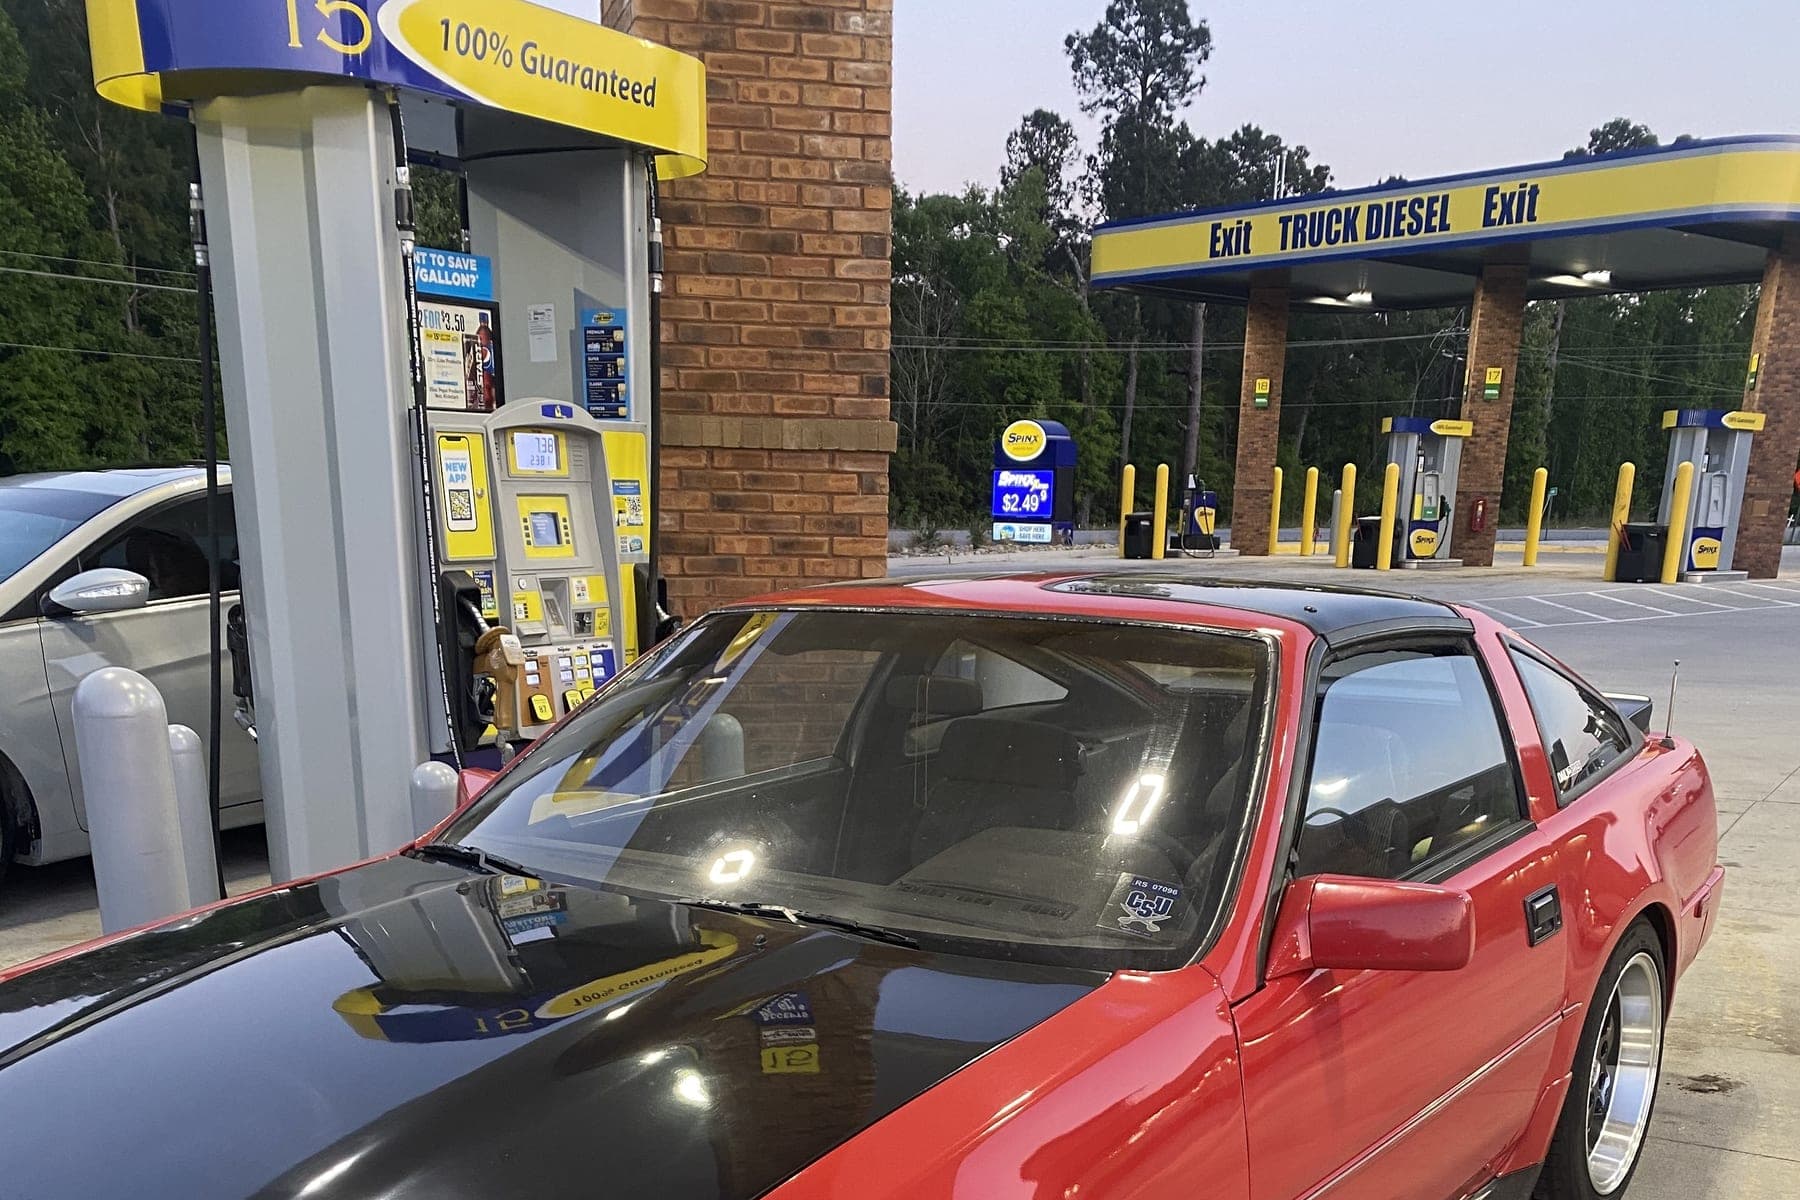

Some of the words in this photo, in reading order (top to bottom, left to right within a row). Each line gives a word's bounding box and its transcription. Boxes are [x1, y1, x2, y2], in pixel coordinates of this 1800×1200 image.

[286, 0, 372, 54] 15
[440, 18, 513, 68] 100%
[520, 41, 657, 109] Guaranteed
[1209, 219, 1252, 258] Exit
[1279, 205, 1361, 251] TRUCK
[1365, 193, 1450, 241] DIESEL
[1482, 182, 1540, 228] Exit
[413, 251, 427, 265] NT
[429, 253, 446, 267] TO
[447, 255, 478, 272] SAVE
[441, 310, 465, 332] $3.50
[1488, 370, 1501, 380] 17
[444, 462, 468, 472] NEW
[448, 474, 467, 483] APP
[1134, 879, 1148, 888] RS
[1125, 890, 1174, 919] CSU
